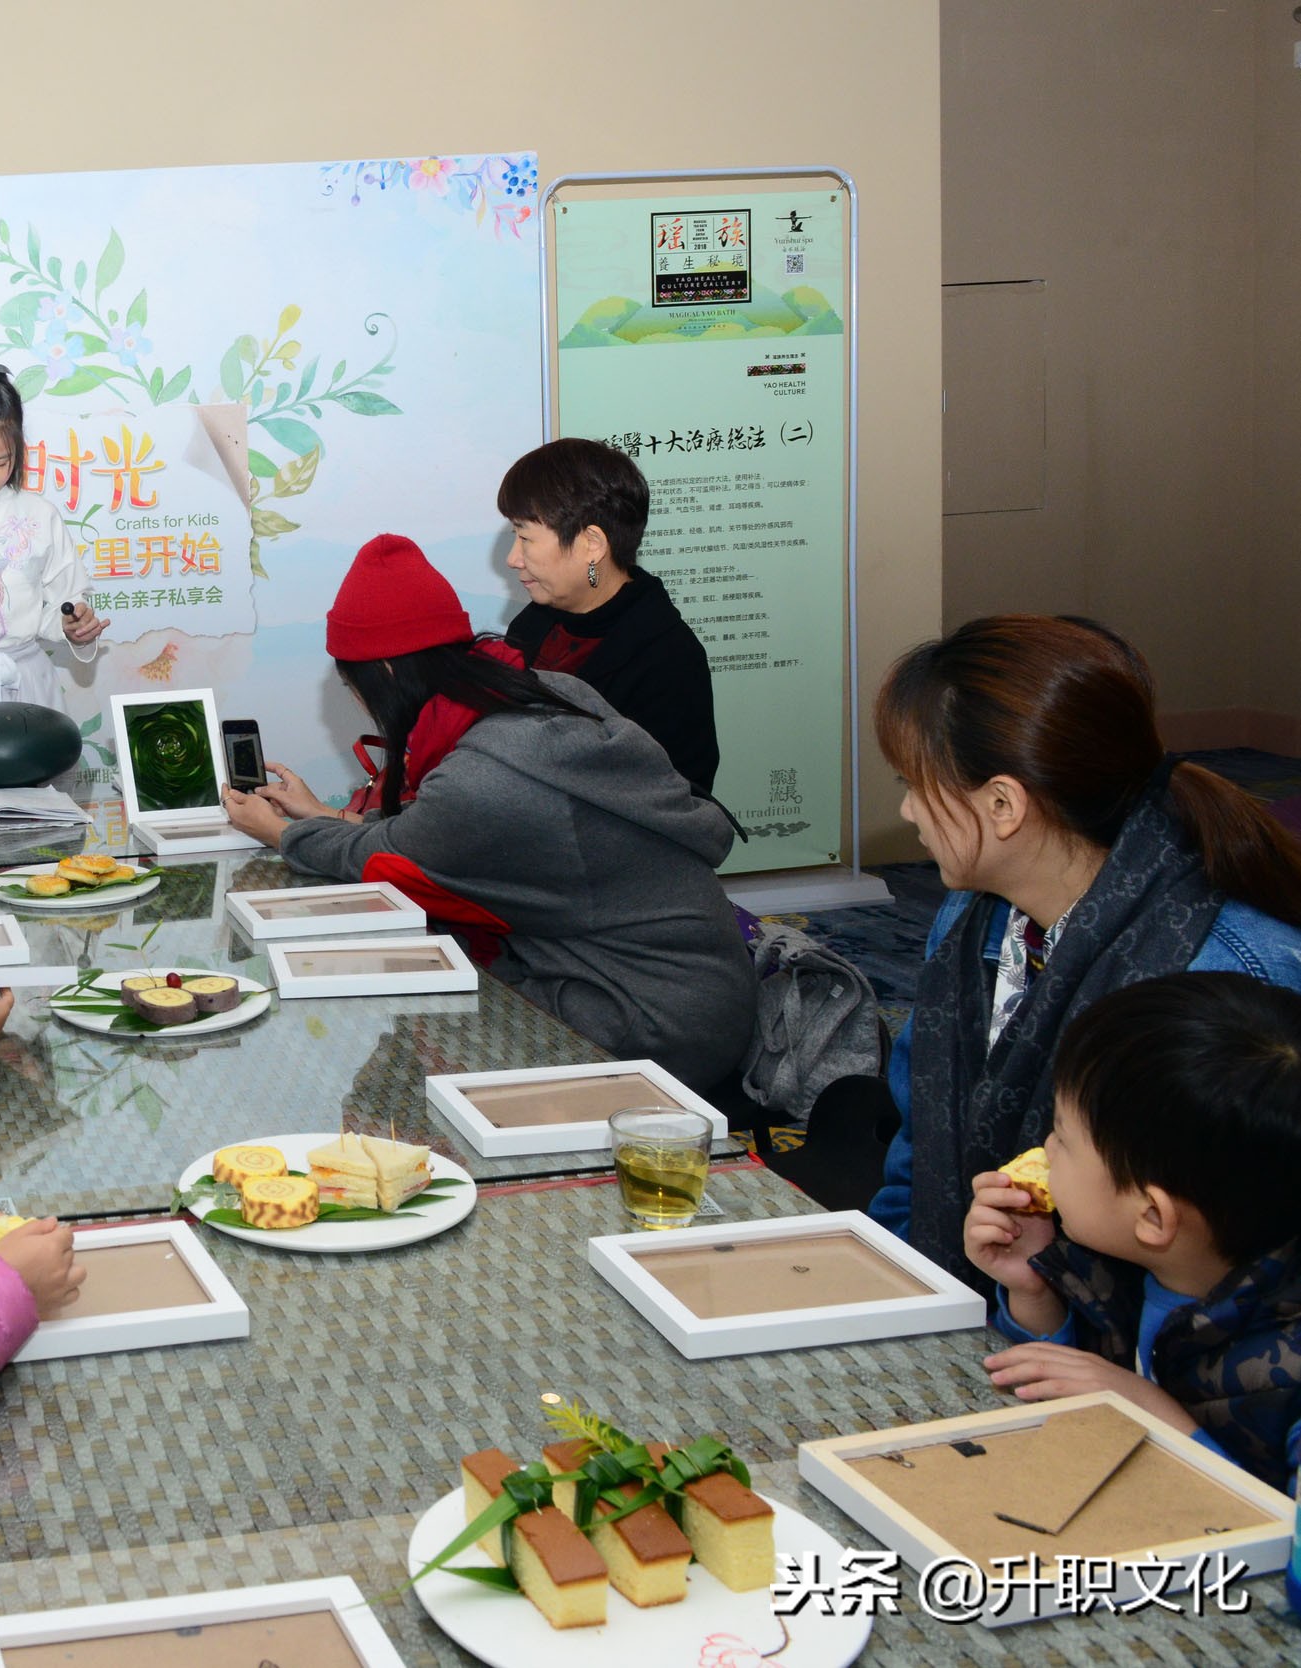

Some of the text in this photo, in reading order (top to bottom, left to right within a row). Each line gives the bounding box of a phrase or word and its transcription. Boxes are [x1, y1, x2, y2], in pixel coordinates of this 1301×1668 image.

[657, 218, 685, 251] 瑶
[714, 216, 746, 248] 族
[661, 280, 742, 290] CULTURE GALLERY
[779, 380, 806, 388] HEALTH
[773, 388, 806, 396] CULTURE
[115, 512, 219, 531] Crafts for Kids
[78, 532, 222, 579] 里开始
[746, 805, 801, 819] tradition
